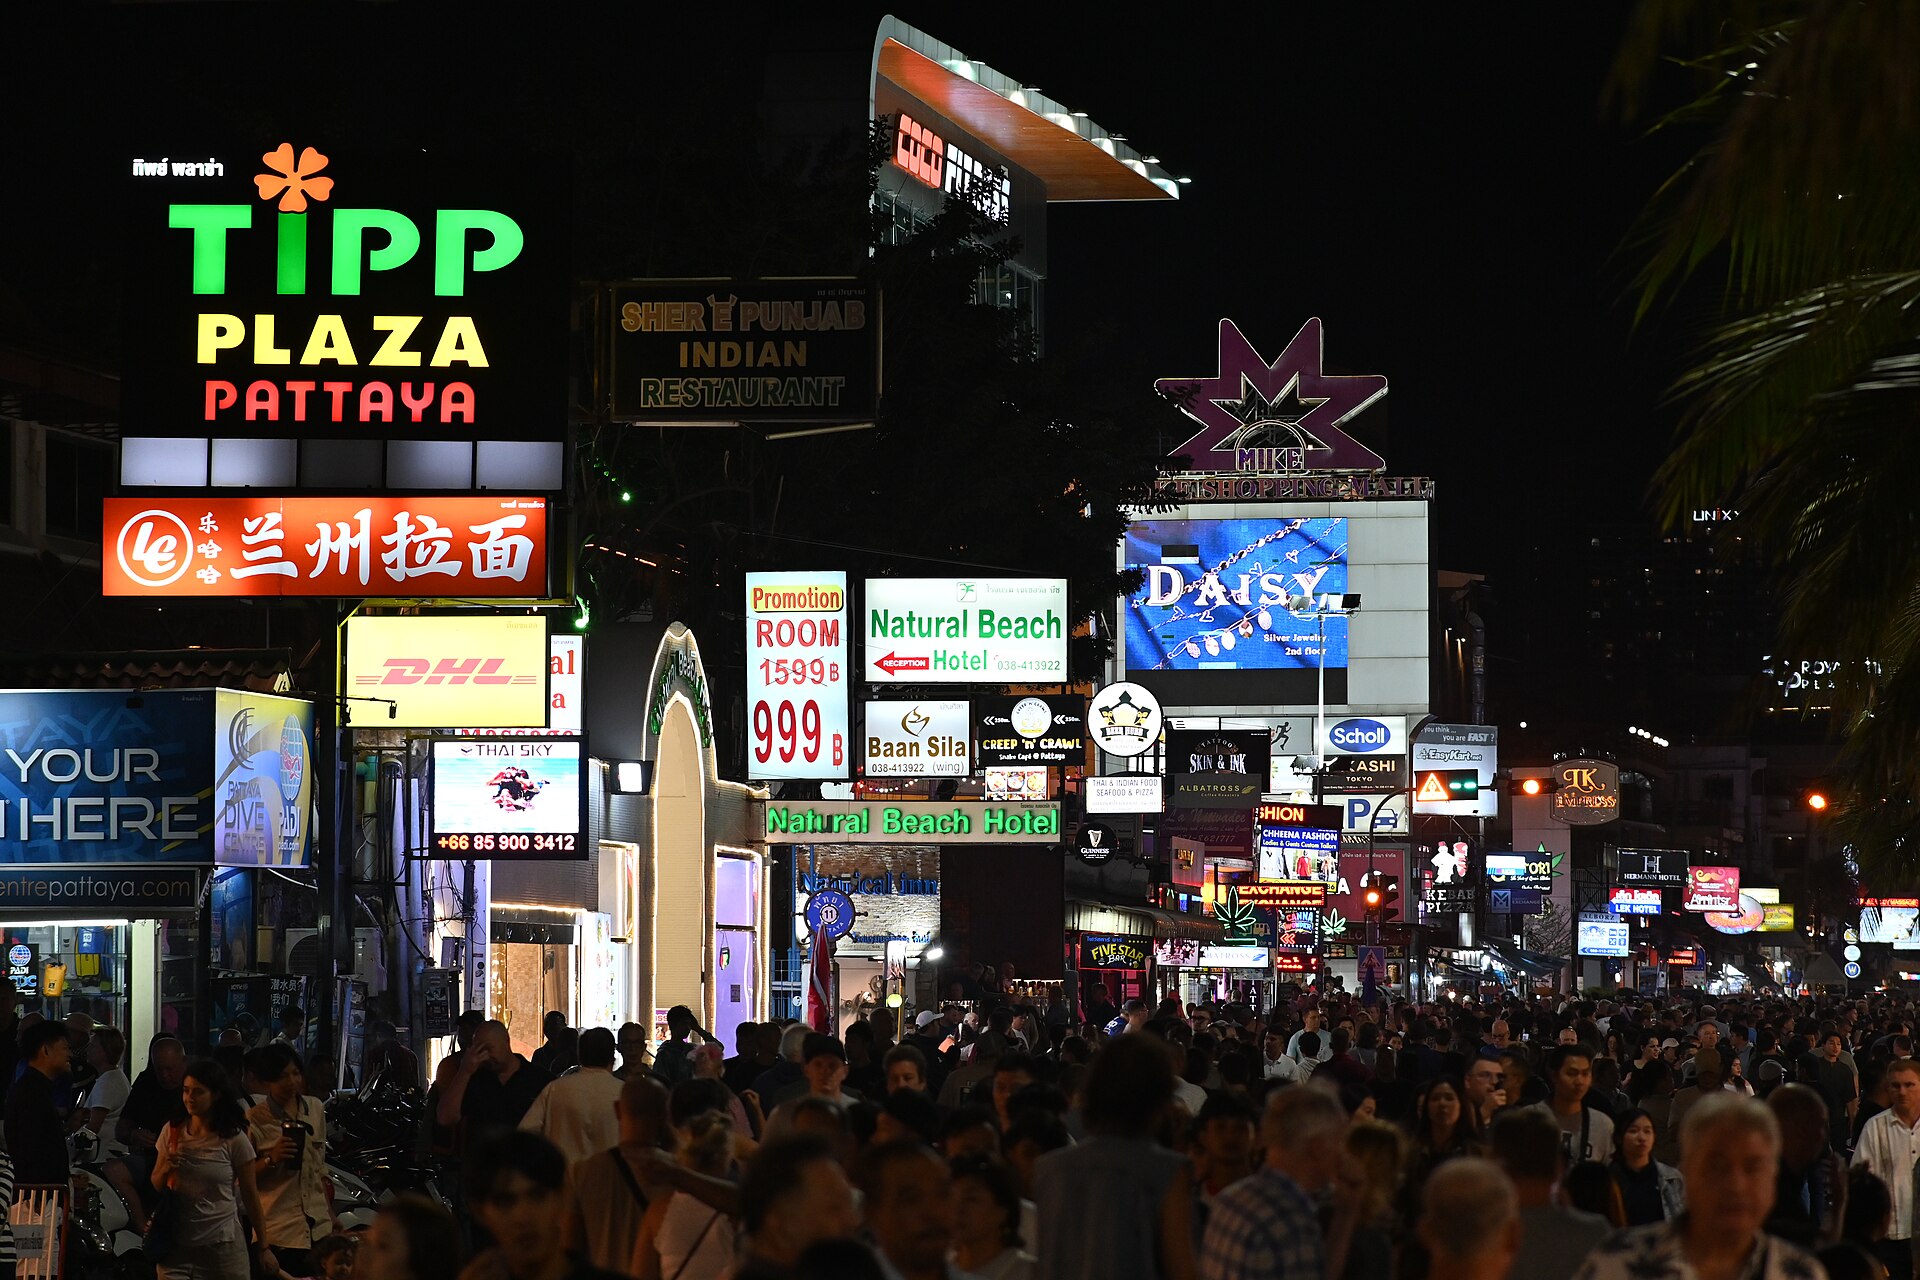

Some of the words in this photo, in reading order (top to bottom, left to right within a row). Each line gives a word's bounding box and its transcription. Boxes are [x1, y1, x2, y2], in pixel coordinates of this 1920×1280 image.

[621, 301, 706, 332] SHER
[740, 300, 866, 332] PUNJAB
[197, 313, 489, 368] PLAZA
[679, 340, 807, 368] INDIAN
[205, 380, 475, 423] PATTAYA
[641, 376, 845, 408] RESTAURANT
[1239, 448, 1303, 470] MIKE
[1199, 479, 1340, 500] SHOPPING
[229, 507, 535, 586] 兰州拉面
[1146, 565, 1329, 607] DAISY
[753, 587, 839, 611] Promotion
[757, 619, 839, 648] ROOM
[871, 609, 968, 638] Natural
[978, 609, 1061, 639] Beach
[1263, 633, 1291, 642] Silver
[933, 650, 987, 671] Hotel
[997, 660, 1061, 671] 038-413922
[1285, 647, 1302, 656] 2nd
[380, 658, 513, 685] DHL
[760, 658, 825, 686] 1599
[883, 659, 926, 668] RECEPTION
[754, 699, 822, 764] 999
[1334, 726, 1385, 744] Scholl
[1467, 732, 1490, 742] FAST
[475, 744, 515, 756] THAI
[520, 744, 553, 757] SKY
[869, 736, 921, 758] Baan
[927, 735, 967, 758] Sila
[982, 738, 1018, 750] CREEP
[1039, 738, 1083, 750] CRAWL
[1201, 737, 1233, 749] TATTOO
[5, 748, 160, 783] YOUR
[1189, 753, 1212, 774] SKIN
[1217, 754, 1225, 769] &
[1230, 753, 1246, 774] INK
[1428, 749, 1482, 763] EasyKart.net
[872, 763, 926, 773] 038-413922
[932, 761, 965, 776] (wing)
[228, 780, 262, 799] PATTAYA
[1092, 778, 1107, 787] THAI
[1115, 778, 1139, 787] INDIAN
[1140, 778, 1158, 787] FOOD
[1179, 784, 1240, 792] ALBATROSS
[1096, 788, 1126, 797] SEAFOOD
[1135, 788, 1154, 796] PIZZA
[21, 797, 199, 841] HERE
[224, 800, 265, 831] DIVE
[278, 804, 301, 838] PADI
[768, 807, 869, 834] Natural
[883, 807, 970, 834] Beach
[984, 807, 1058, 834] Hotel
[223, 832, 265, 852] CENTRE
[438, 834, 469, 851] +66
[473, 834, 495, 851] 85
[499, 834, 530, 851] 900
[534, 834, 575, 851] 3412
[1263, 829, 1301, 839] CHHEENA
[1302, 831, 1338, 841] FASHION
[900, 873, 938, 895] inn
[1426, 889, 1476, 901] KEBAB
[824, 909, 833, 919] 11
[1286, 911, 1314, 923] CANNA
[1426, 902, 1474, 913] PIZZA
[1583, 913, 1615, 921] ALBORZ
[1615, 904, 1631, 913] LEK
[1633, 905, 1659, 914] HOTEL
[1091, 943, 1117, 961] FIVE
[1117, 944, 1144, 962] STAR
[1107, 954, 1127, 965] BAR
[10, 966, 29, 974] PADI
